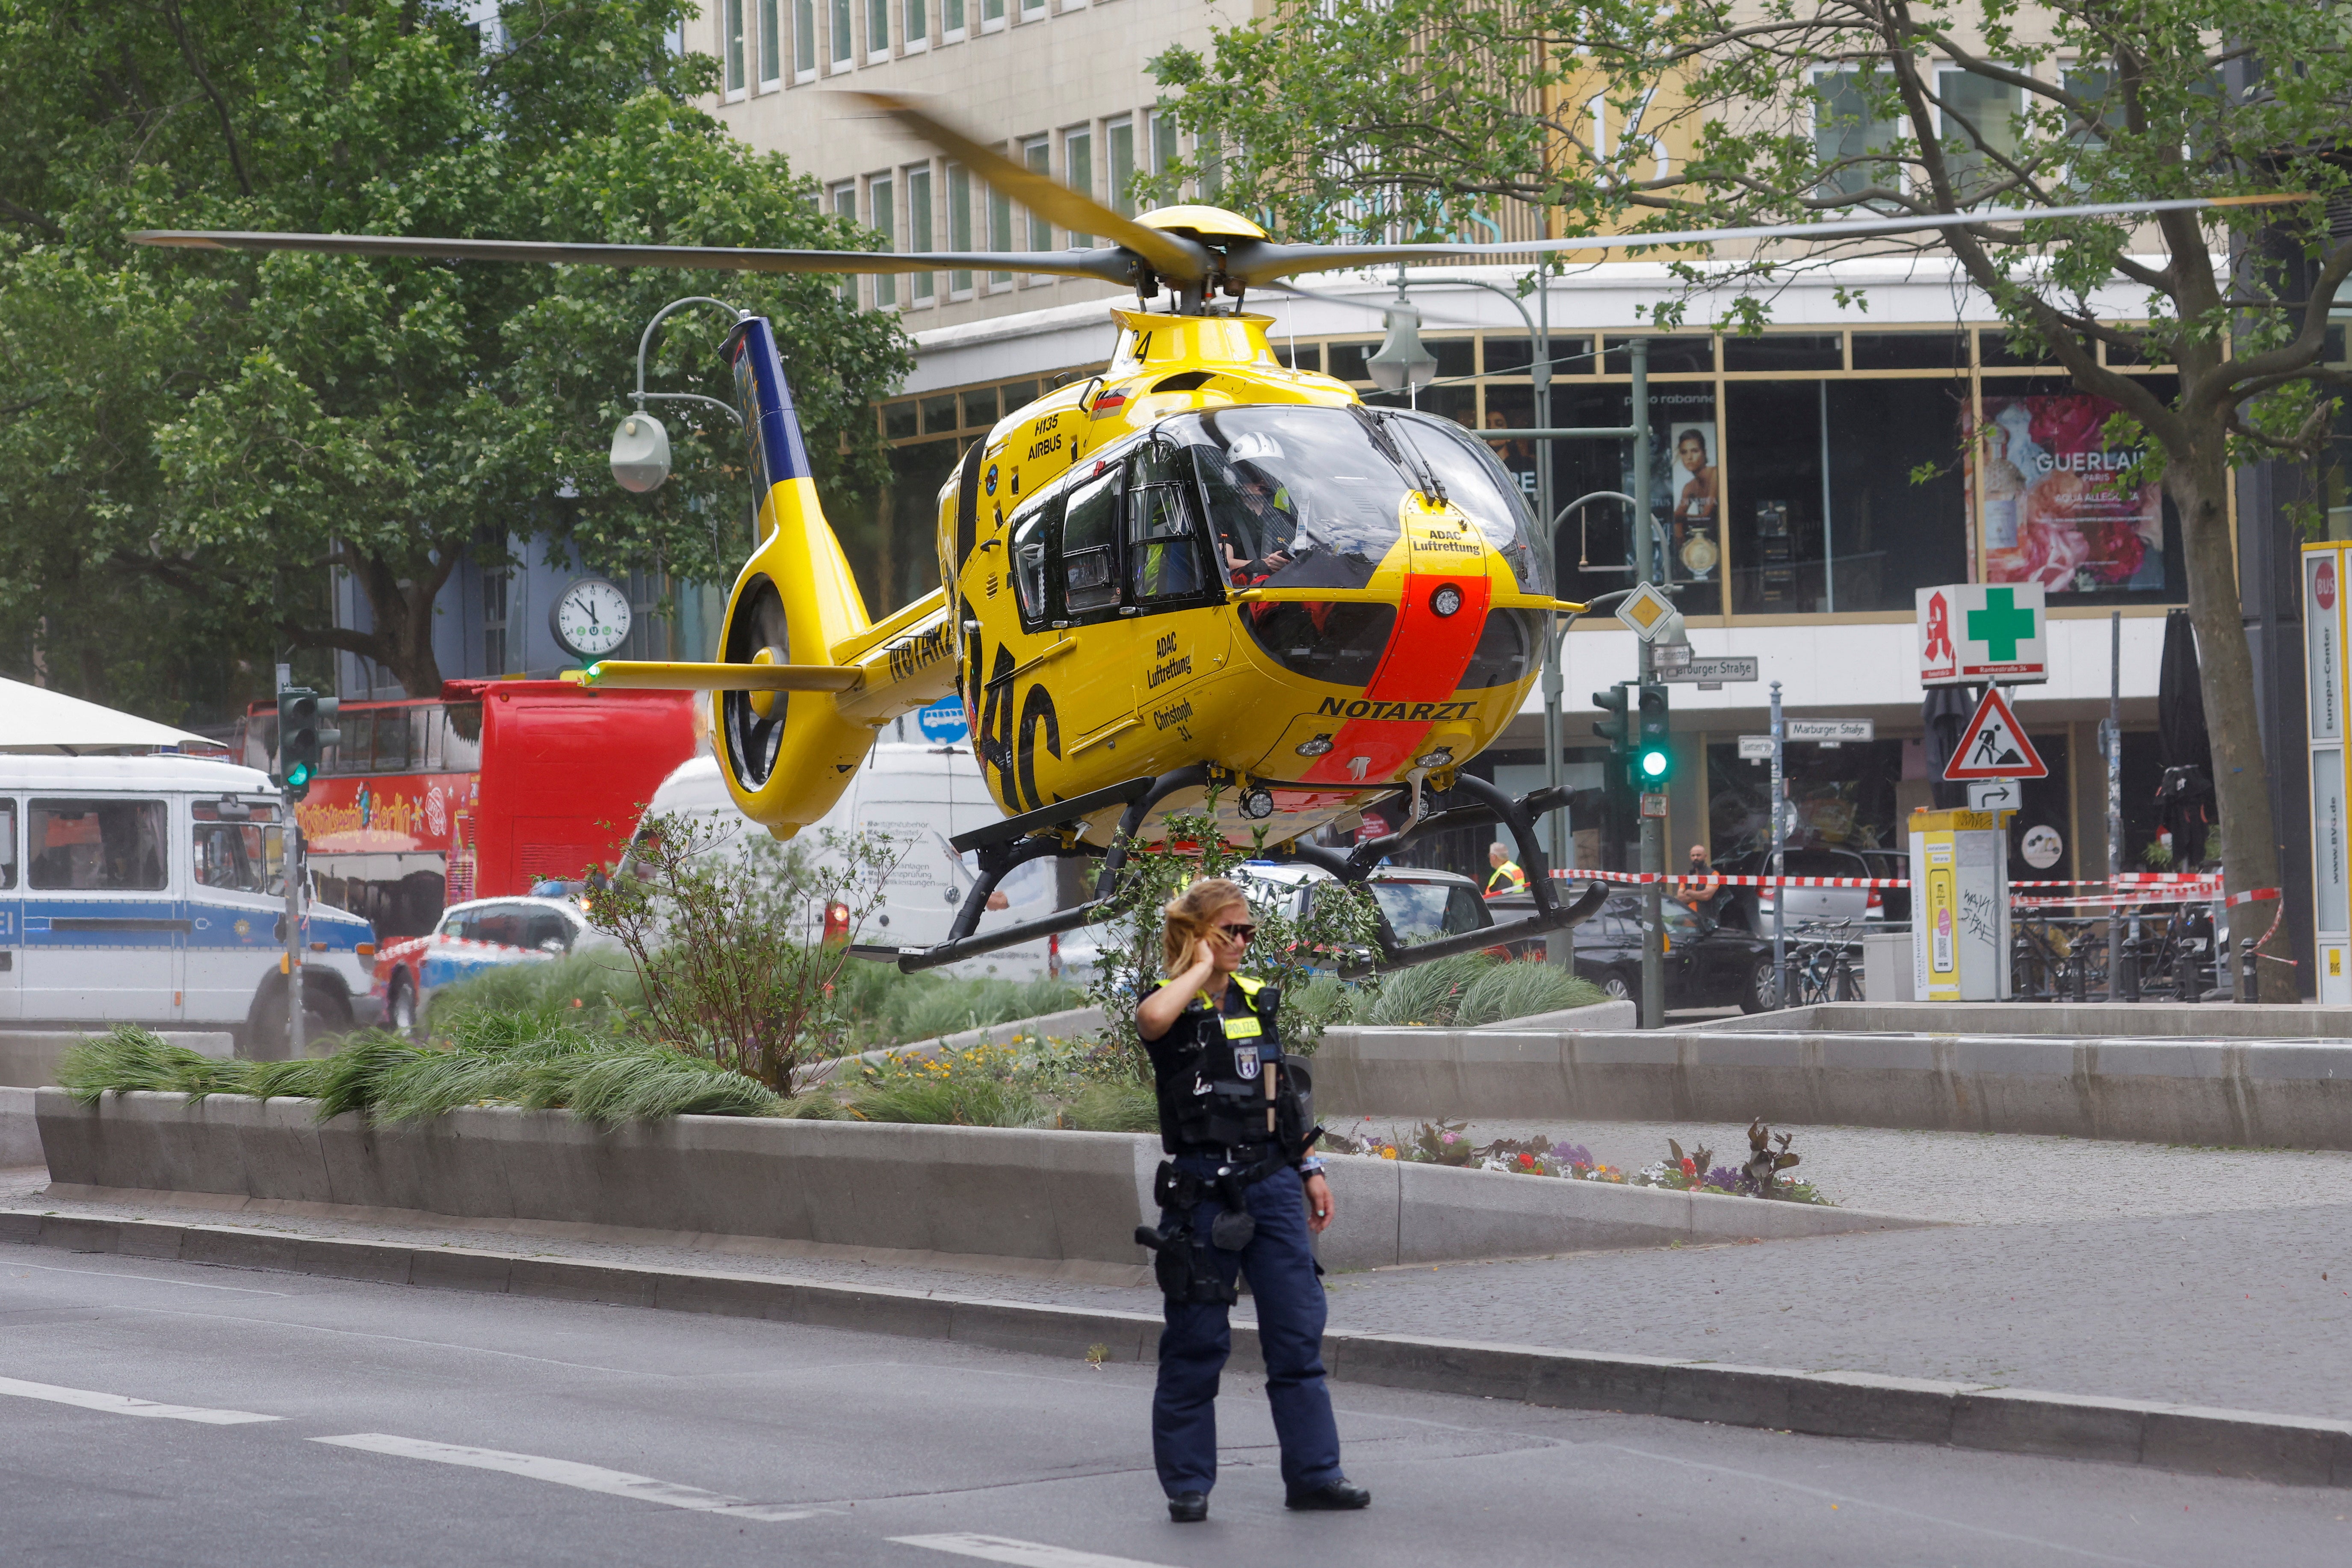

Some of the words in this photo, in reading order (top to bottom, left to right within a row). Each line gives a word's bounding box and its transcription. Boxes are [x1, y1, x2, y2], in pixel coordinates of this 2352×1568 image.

[1624, 396, 1658, 405] po
[1035, 413, 1059, 437] H135
[1028, 433, 1061, 462] AIRBUS
[2082, 472, 2111, 481] PARIS
[1430, 530, 1462, 540] ADAC
[1413, 540, 1480, 555] Luftrettung
[2317, 578, 2335, 594] BUS
[1157, 631, 1177, 660] ADAC
[1147, 654, 1192, 689] Luftrettung
[1677, 665, 1717, 676] arburger
[1720, 661, 1752, 676] Straße
[2324, 622, 2333, 729] Europa-Center
[1154, 697, 1193, 731] Christoph
[1317, 697, 1477, 720] NOTARZT
[1177, 724, 1193, 742] 31
[1793, 724, 1836, 736] Marburger
[1841, 723, 1865, 736] Straße
[2330, 796, 2339, 884] www.BVG.de
[1227, 1021, 1258, 1035] POLIZEI
